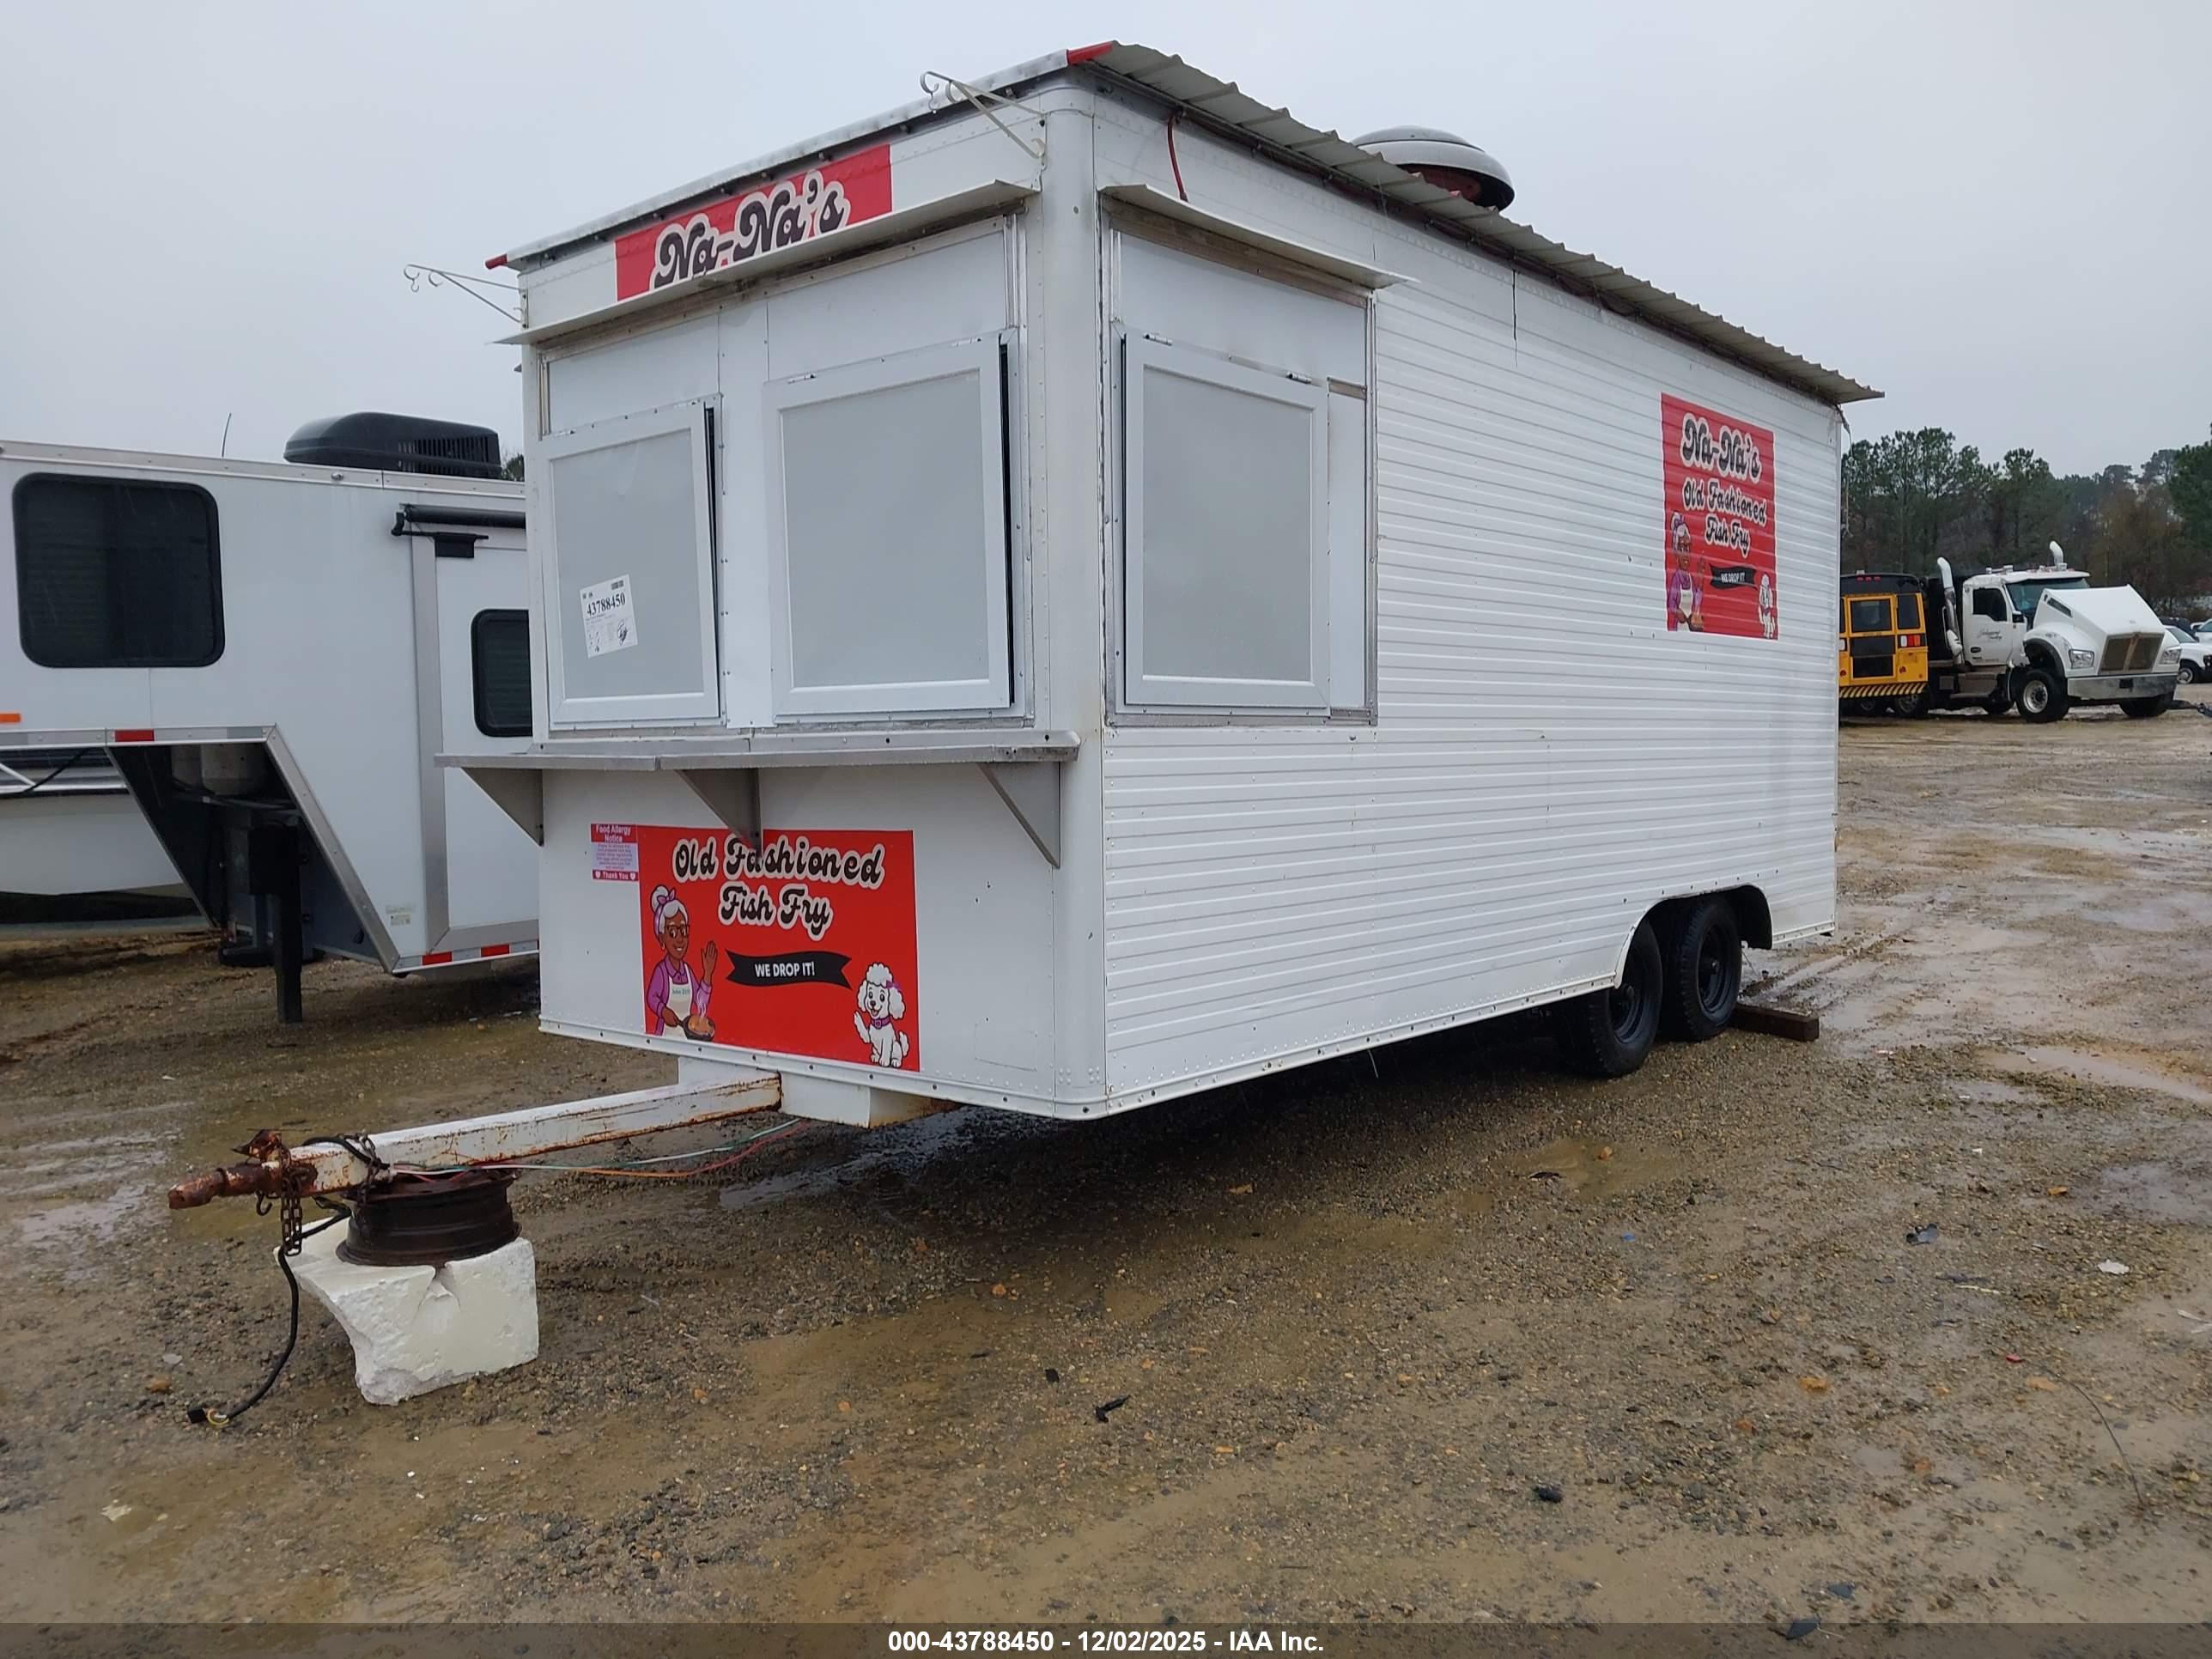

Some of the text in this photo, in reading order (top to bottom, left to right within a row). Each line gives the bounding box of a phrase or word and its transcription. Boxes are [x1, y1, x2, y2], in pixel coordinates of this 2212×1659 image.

[653, 178, 845, 289] Na-Na's
[1681, 417, 1761, 478] Na-Na's
[1684, 481, 1766, 523] Old Fashioned
[1706, 516, 1749, 555] Fish Fry
[586, 592, 626, 617] 43788450
[596, 824, 631, 836] Food Allergy
[605, 835, 623, 843] Notice
[603, 871, 629, 880] Thank You
[675, 841, 716, 878] Old
[726, 836, 882, 884] Fashioned
[720, 885, 830, 936] Fish Fry
[755, 961, 815, 977] WE DROP IT!
